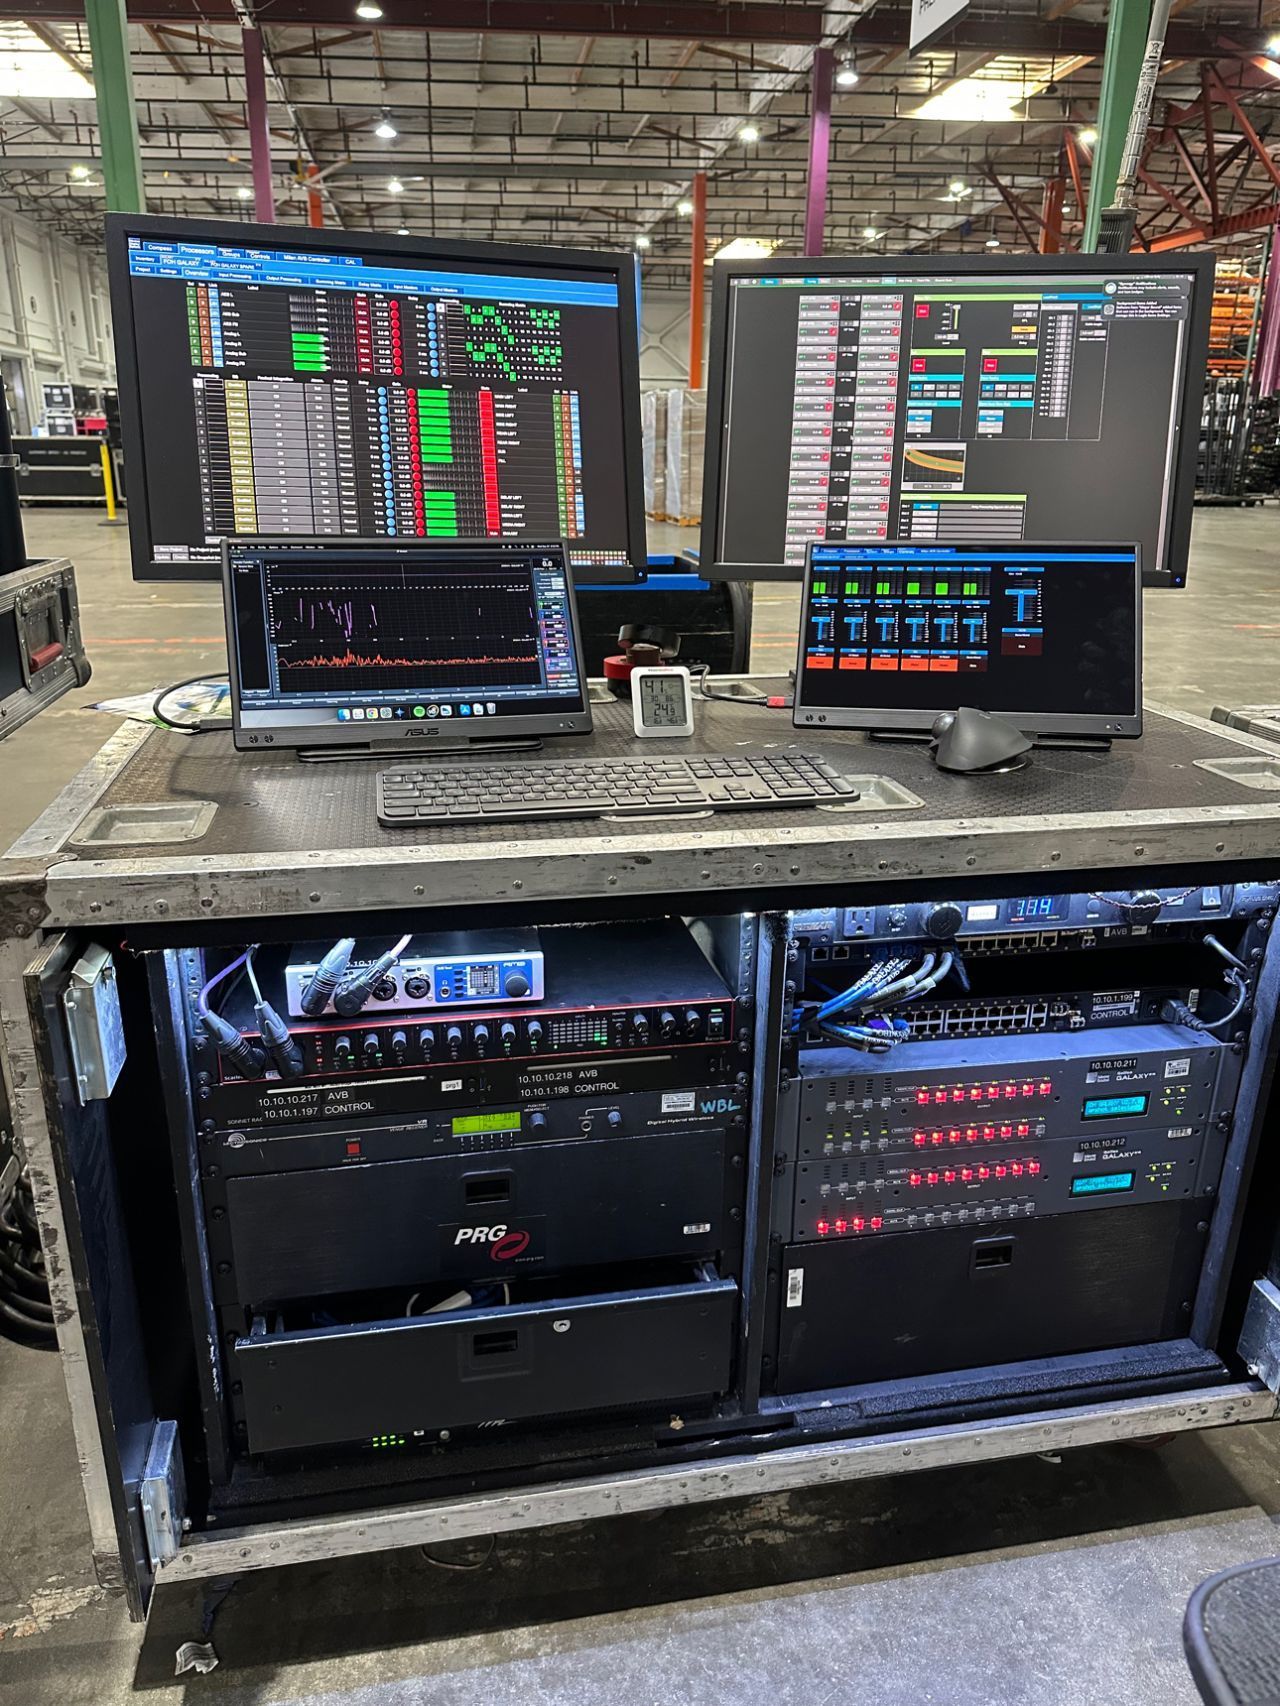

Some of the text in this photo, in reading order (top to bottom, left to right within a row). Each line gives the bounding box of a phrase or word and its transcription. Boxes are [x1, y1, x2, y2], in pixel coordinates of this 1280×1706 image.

[181, 246, 214, 255] Processors
[404, 727, 440, 736] ASUS
[1111, 927, 1127, 936] AVB
[1092, 994, 1133, 1004] 10.10.1.199
[1091, 1009, 1129, 1020] CONTROL
[1091, 1059, 1137, 1069] 10.10.10.211
[519, 1069, 598, 1084] 10.10.10.218 AVB
[520, 1082, 620, 1097] 10.10.1.198 CONTROL
[258, 1091, 349, 1107] 10.10.10.217 AVB
[264, 1101, 375, 1119] 10.10.1.197 CONTROL
[700, 1099, 741, 1114] WBL
[1080, 1138, 1125, 1150] 10.10.10.212
[454, 1224, 508, 1246] PRG
